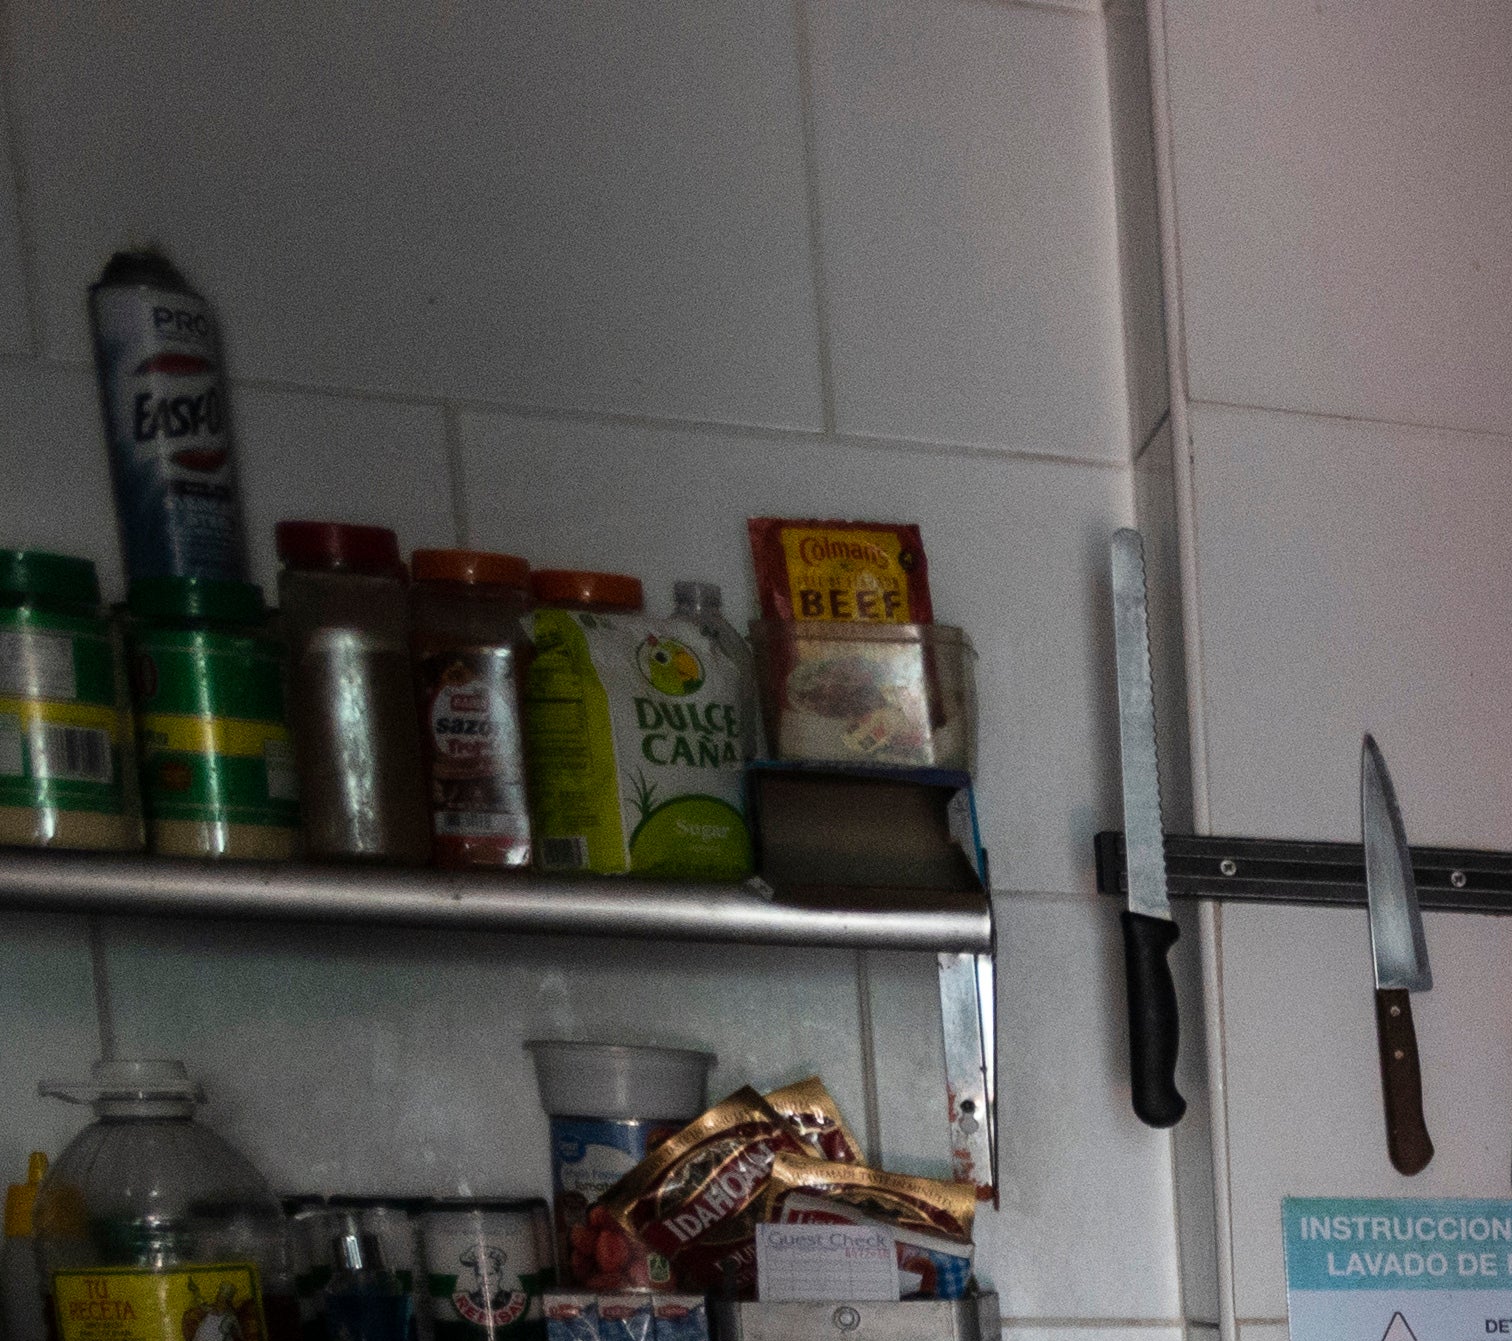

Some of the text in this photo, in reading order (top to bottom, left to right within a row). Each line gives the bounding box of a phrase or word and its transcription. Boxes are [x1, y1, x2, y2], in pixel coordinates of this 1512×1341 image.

[799, 588, 902, 619] BEEF
[437, 717, 495, 736] sazo
[634, 698, 740, 737] DULCE
[641, 735, 739, 770] CAÑA
[662, 1142, 776, 1244] IDAHOAN
[767, 1230, 887, 1251] Guest Check
[1327, 1252, 1449, 1279] LAVADO
[1456, 1252, 1498, 1278] DE
[83, 1279, 110, 1299] TU
[68, 1300, 136, 1321] RECETA
